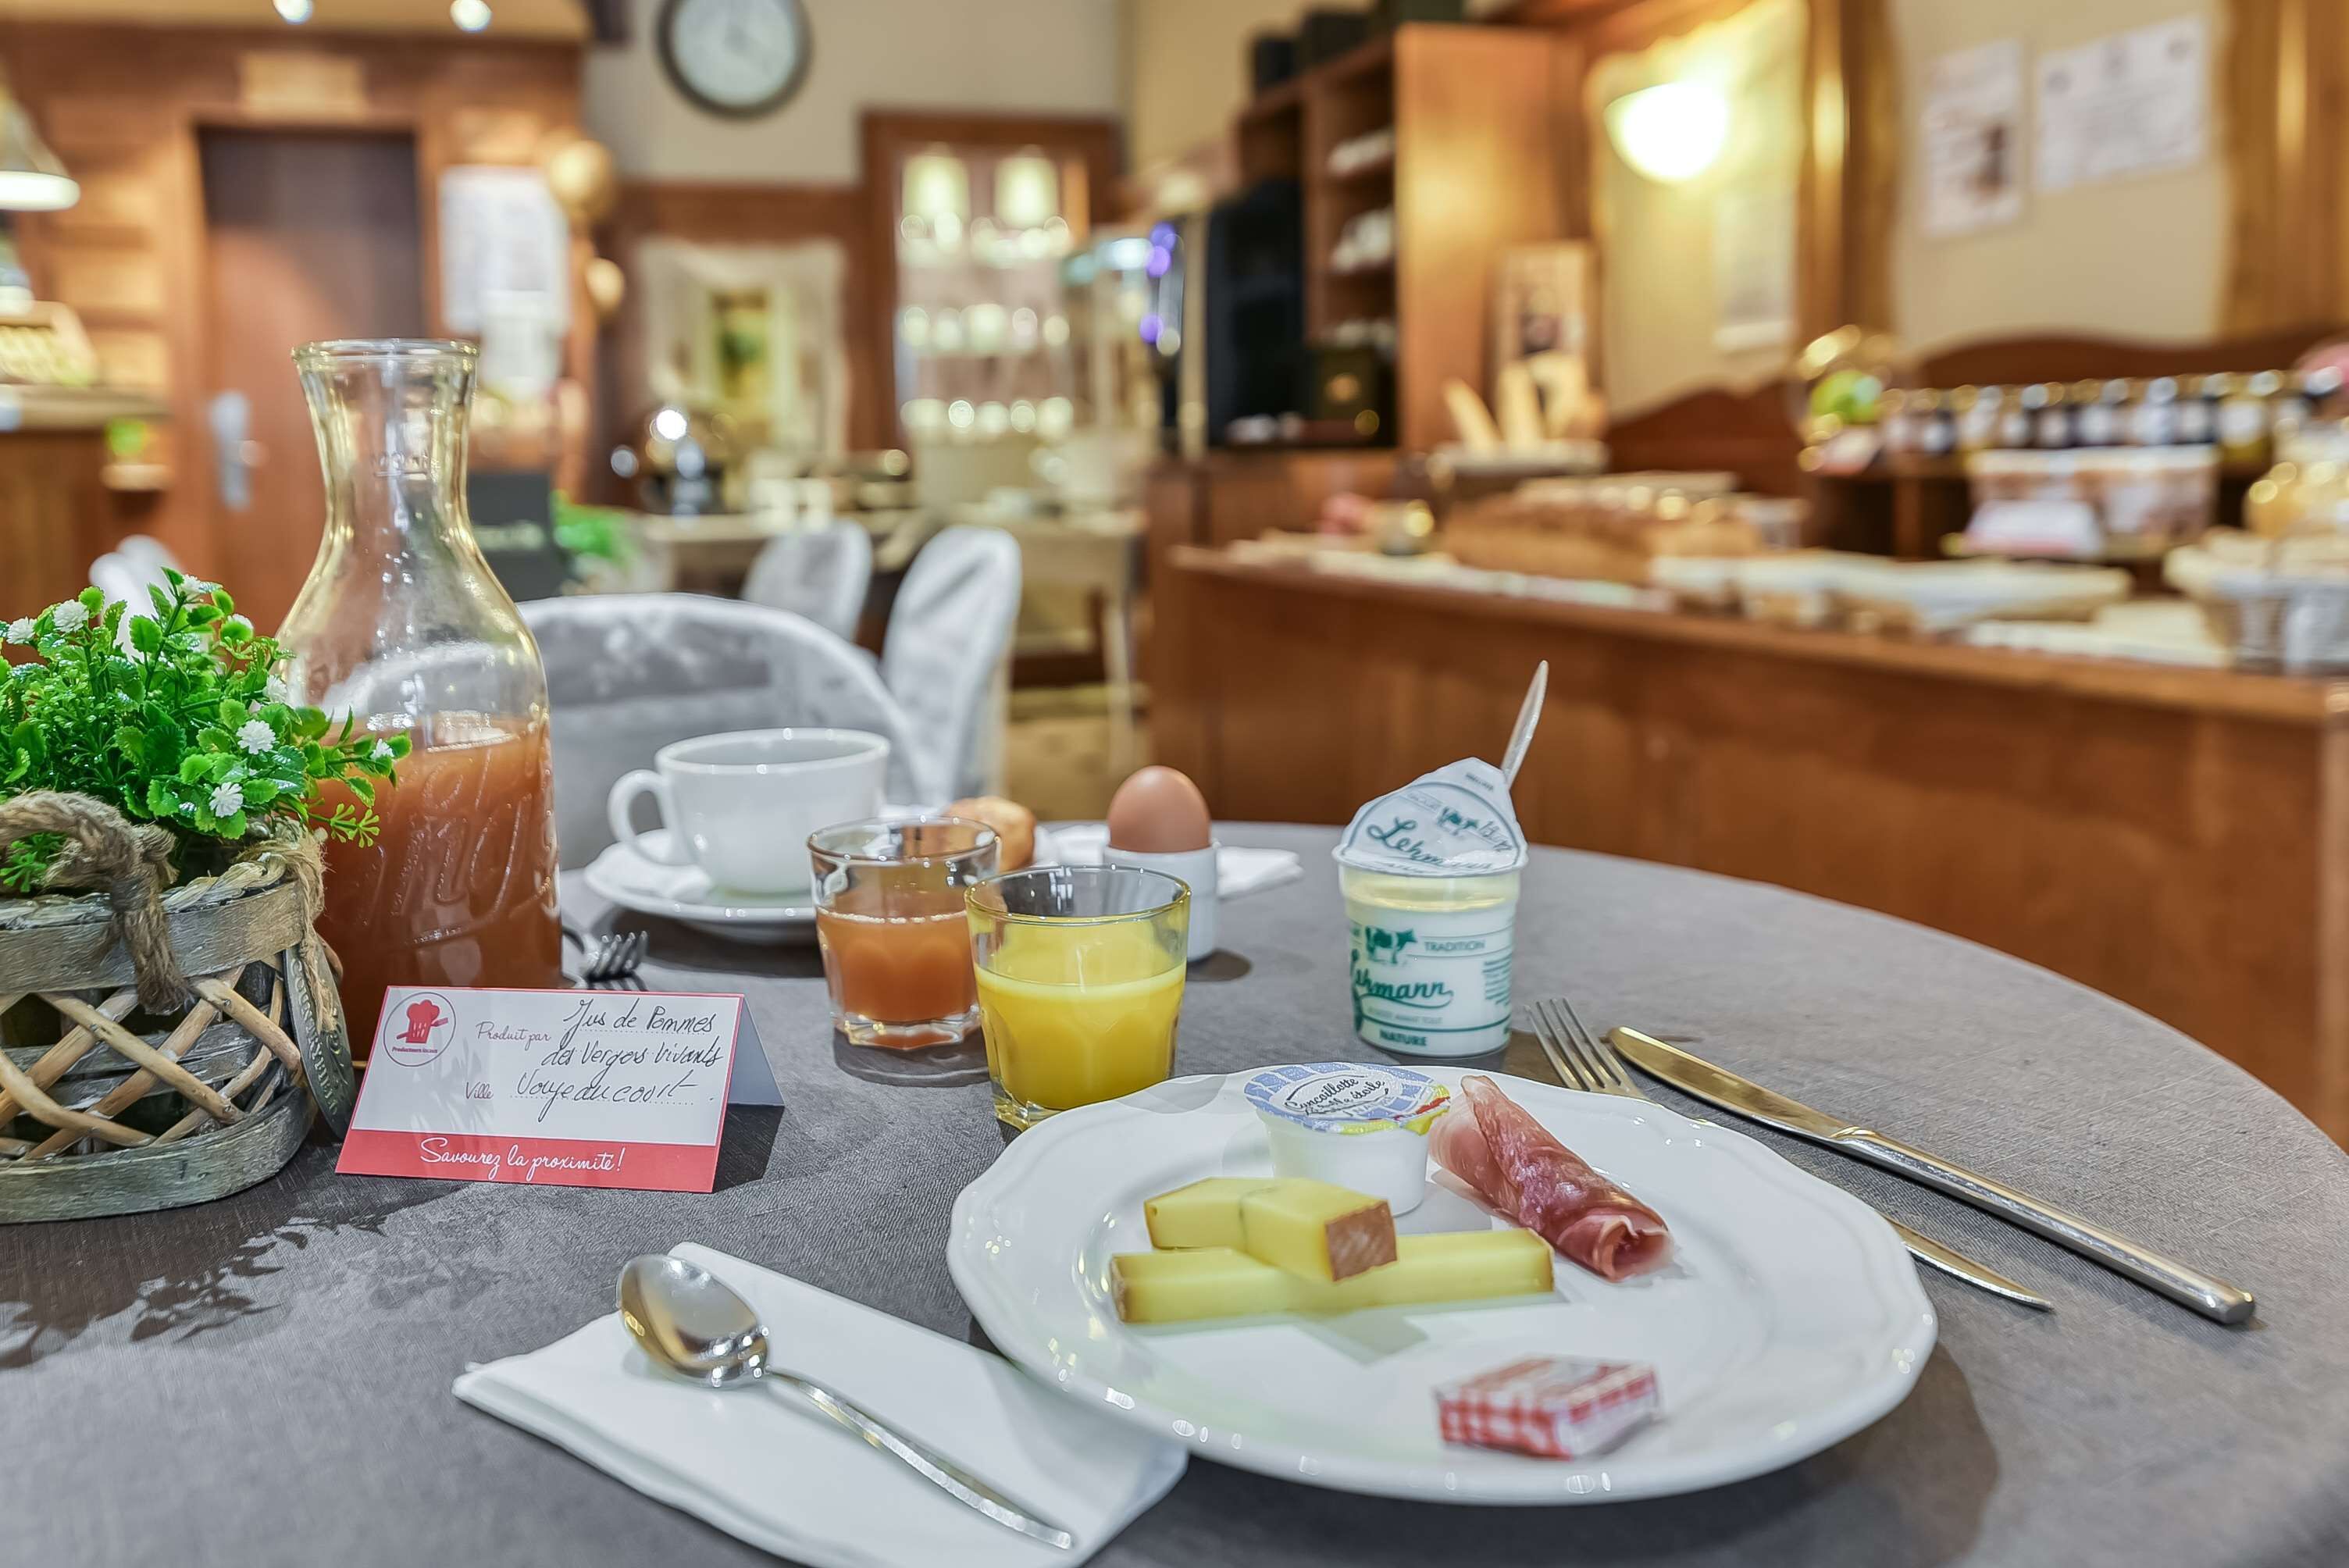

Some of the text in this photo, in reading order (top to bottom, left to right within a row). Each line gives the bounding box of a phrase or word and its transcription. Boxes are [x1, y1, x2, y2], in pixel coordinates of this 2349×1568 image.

[1424, 941, 1486, 951] TRADITION
[475, 1021, 551, 1051] Produit par
[562, 997, 717, 1050] Jus de Pommes
[1380, 1029, 1428, 1046] NATURE
[540, 1031, 576, 1066] des
[465, 1081, 494, 1099] Ville
[419, 1137, 626, 1182] Savourez la proximité!
